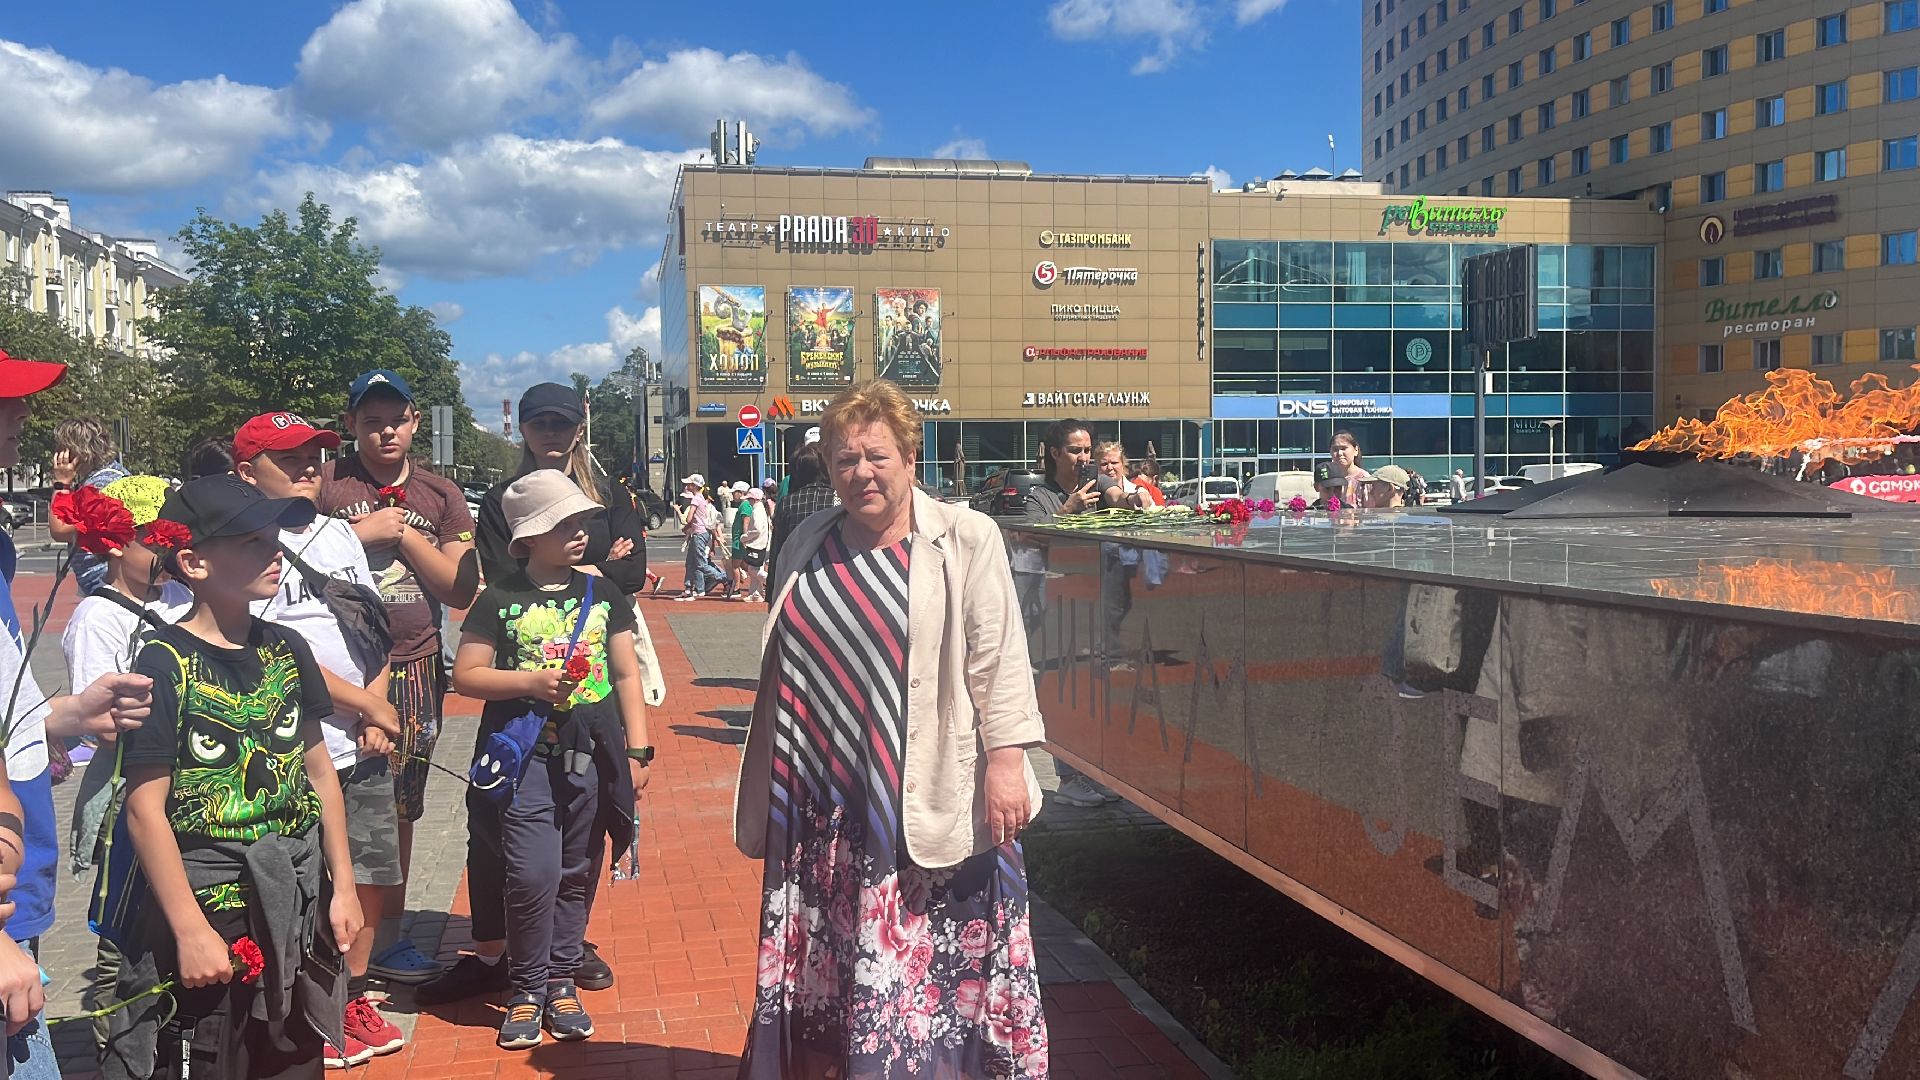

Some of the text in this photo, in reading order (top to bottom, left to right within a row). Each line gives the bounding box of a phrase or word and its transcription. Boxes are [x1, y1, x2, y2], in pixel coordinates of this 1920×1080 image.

[706, 222, 759, 233] ТЕАТР
[779, 214, 848, 244] PRADA
[897, 227, 950, 237] КИНО
[1059, 233, 1132, 246] ГАЗПРОМБАНК
[1051, 304, 1121, 314] ПИКО ПИЦЦА
[1724, 317, 1816, 338] ресторан
[1038, 391, 1150, 405] ВАЙТ СТАР ЛАУНЖ
[1280, 399, 1329, 415] DNS
